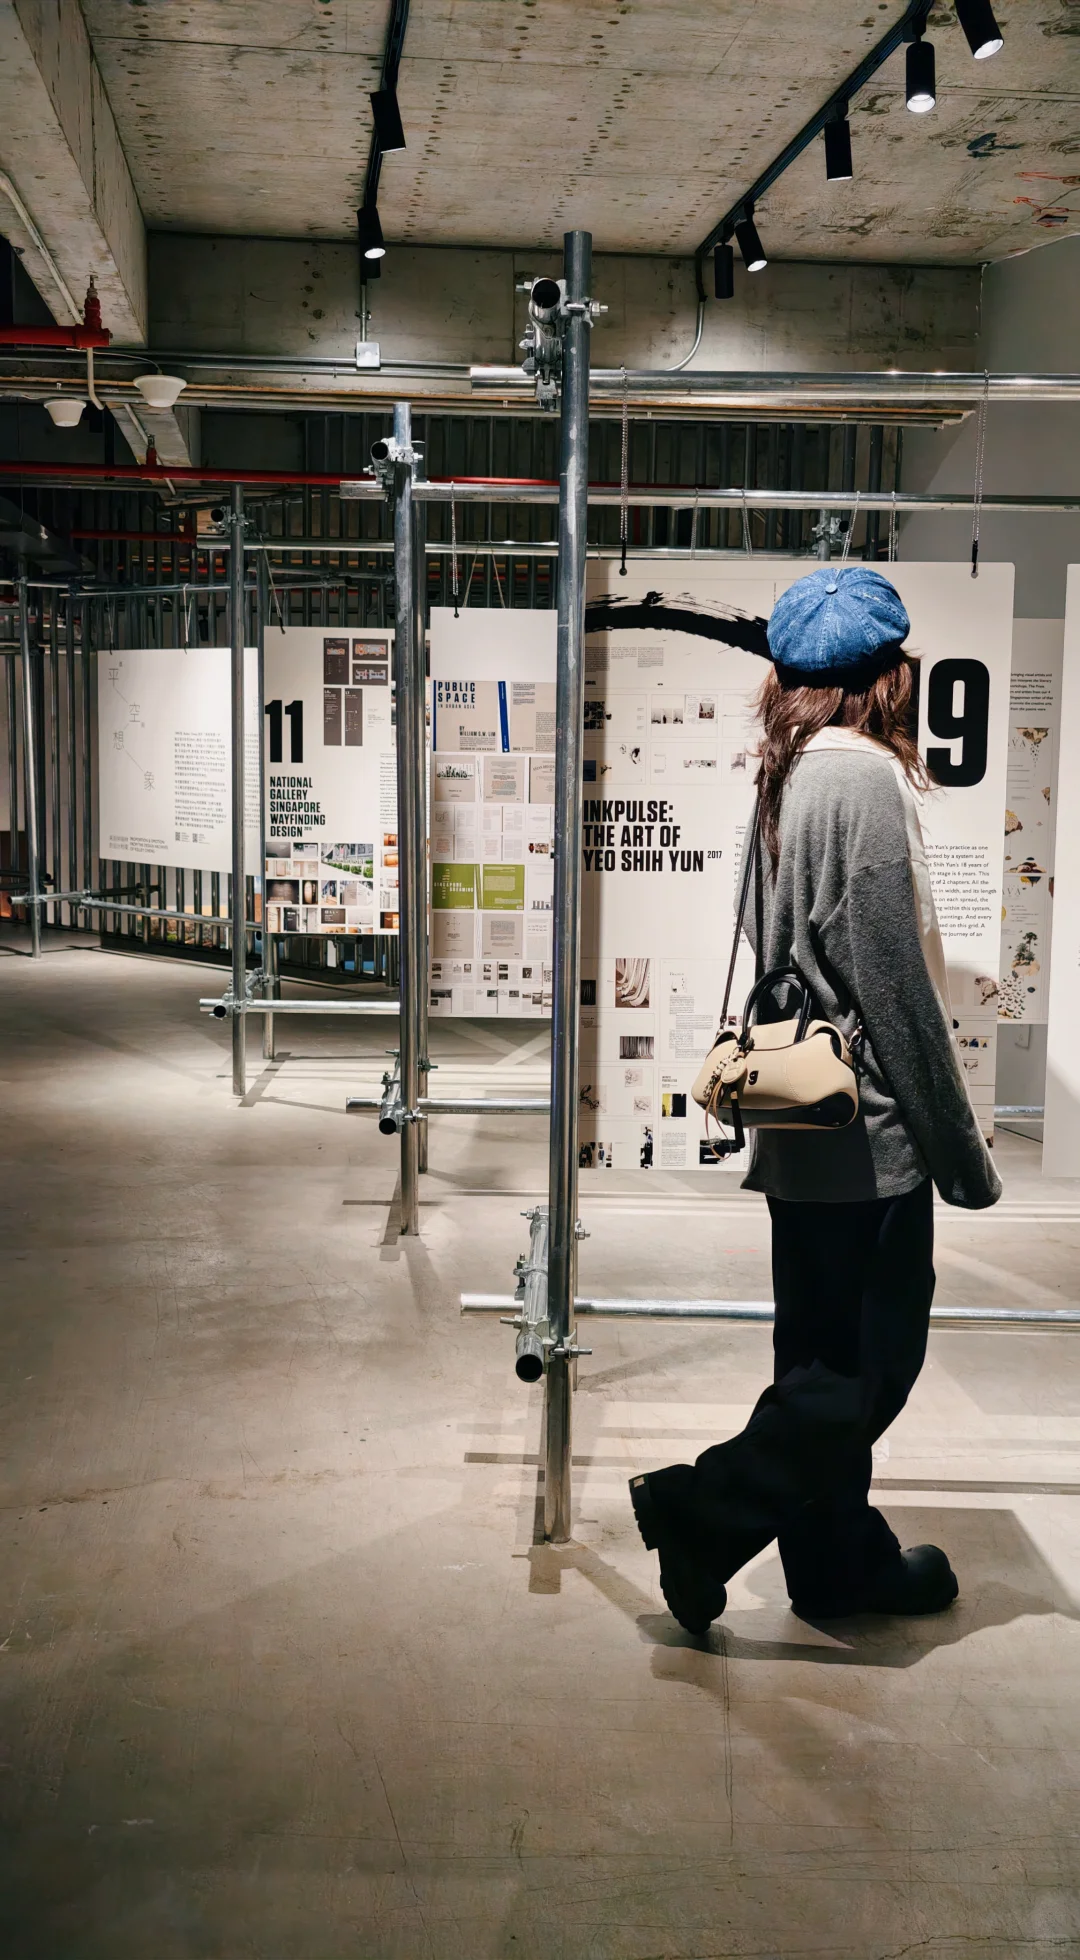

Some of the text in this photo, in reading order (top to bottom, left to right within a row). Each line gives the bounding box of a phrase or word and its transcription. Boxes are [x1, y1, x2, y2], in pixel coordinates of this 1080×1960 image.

[438, 682, 475, 692] PUBLIC
[438, 693, 475, 703] SPACE
[265, 700, 303, 763] 11
[270, 776, 313, 788] NATIONAL
[270, 788, 308, 800] GALLERY
[270, 801, 321, 813] SINGAPORE
[583, 800, 673, 822] INKPULSE:
[270, 814, 326, 825] WAYFINDING
[270, 826, 303, 837] DESIGN
[583, 825, 681, 847] THE ART OF
[583, 850, 615, 872] YEO
[621, 850, 663, 872] SHIH
[669, 850, 704, 872] YUN
